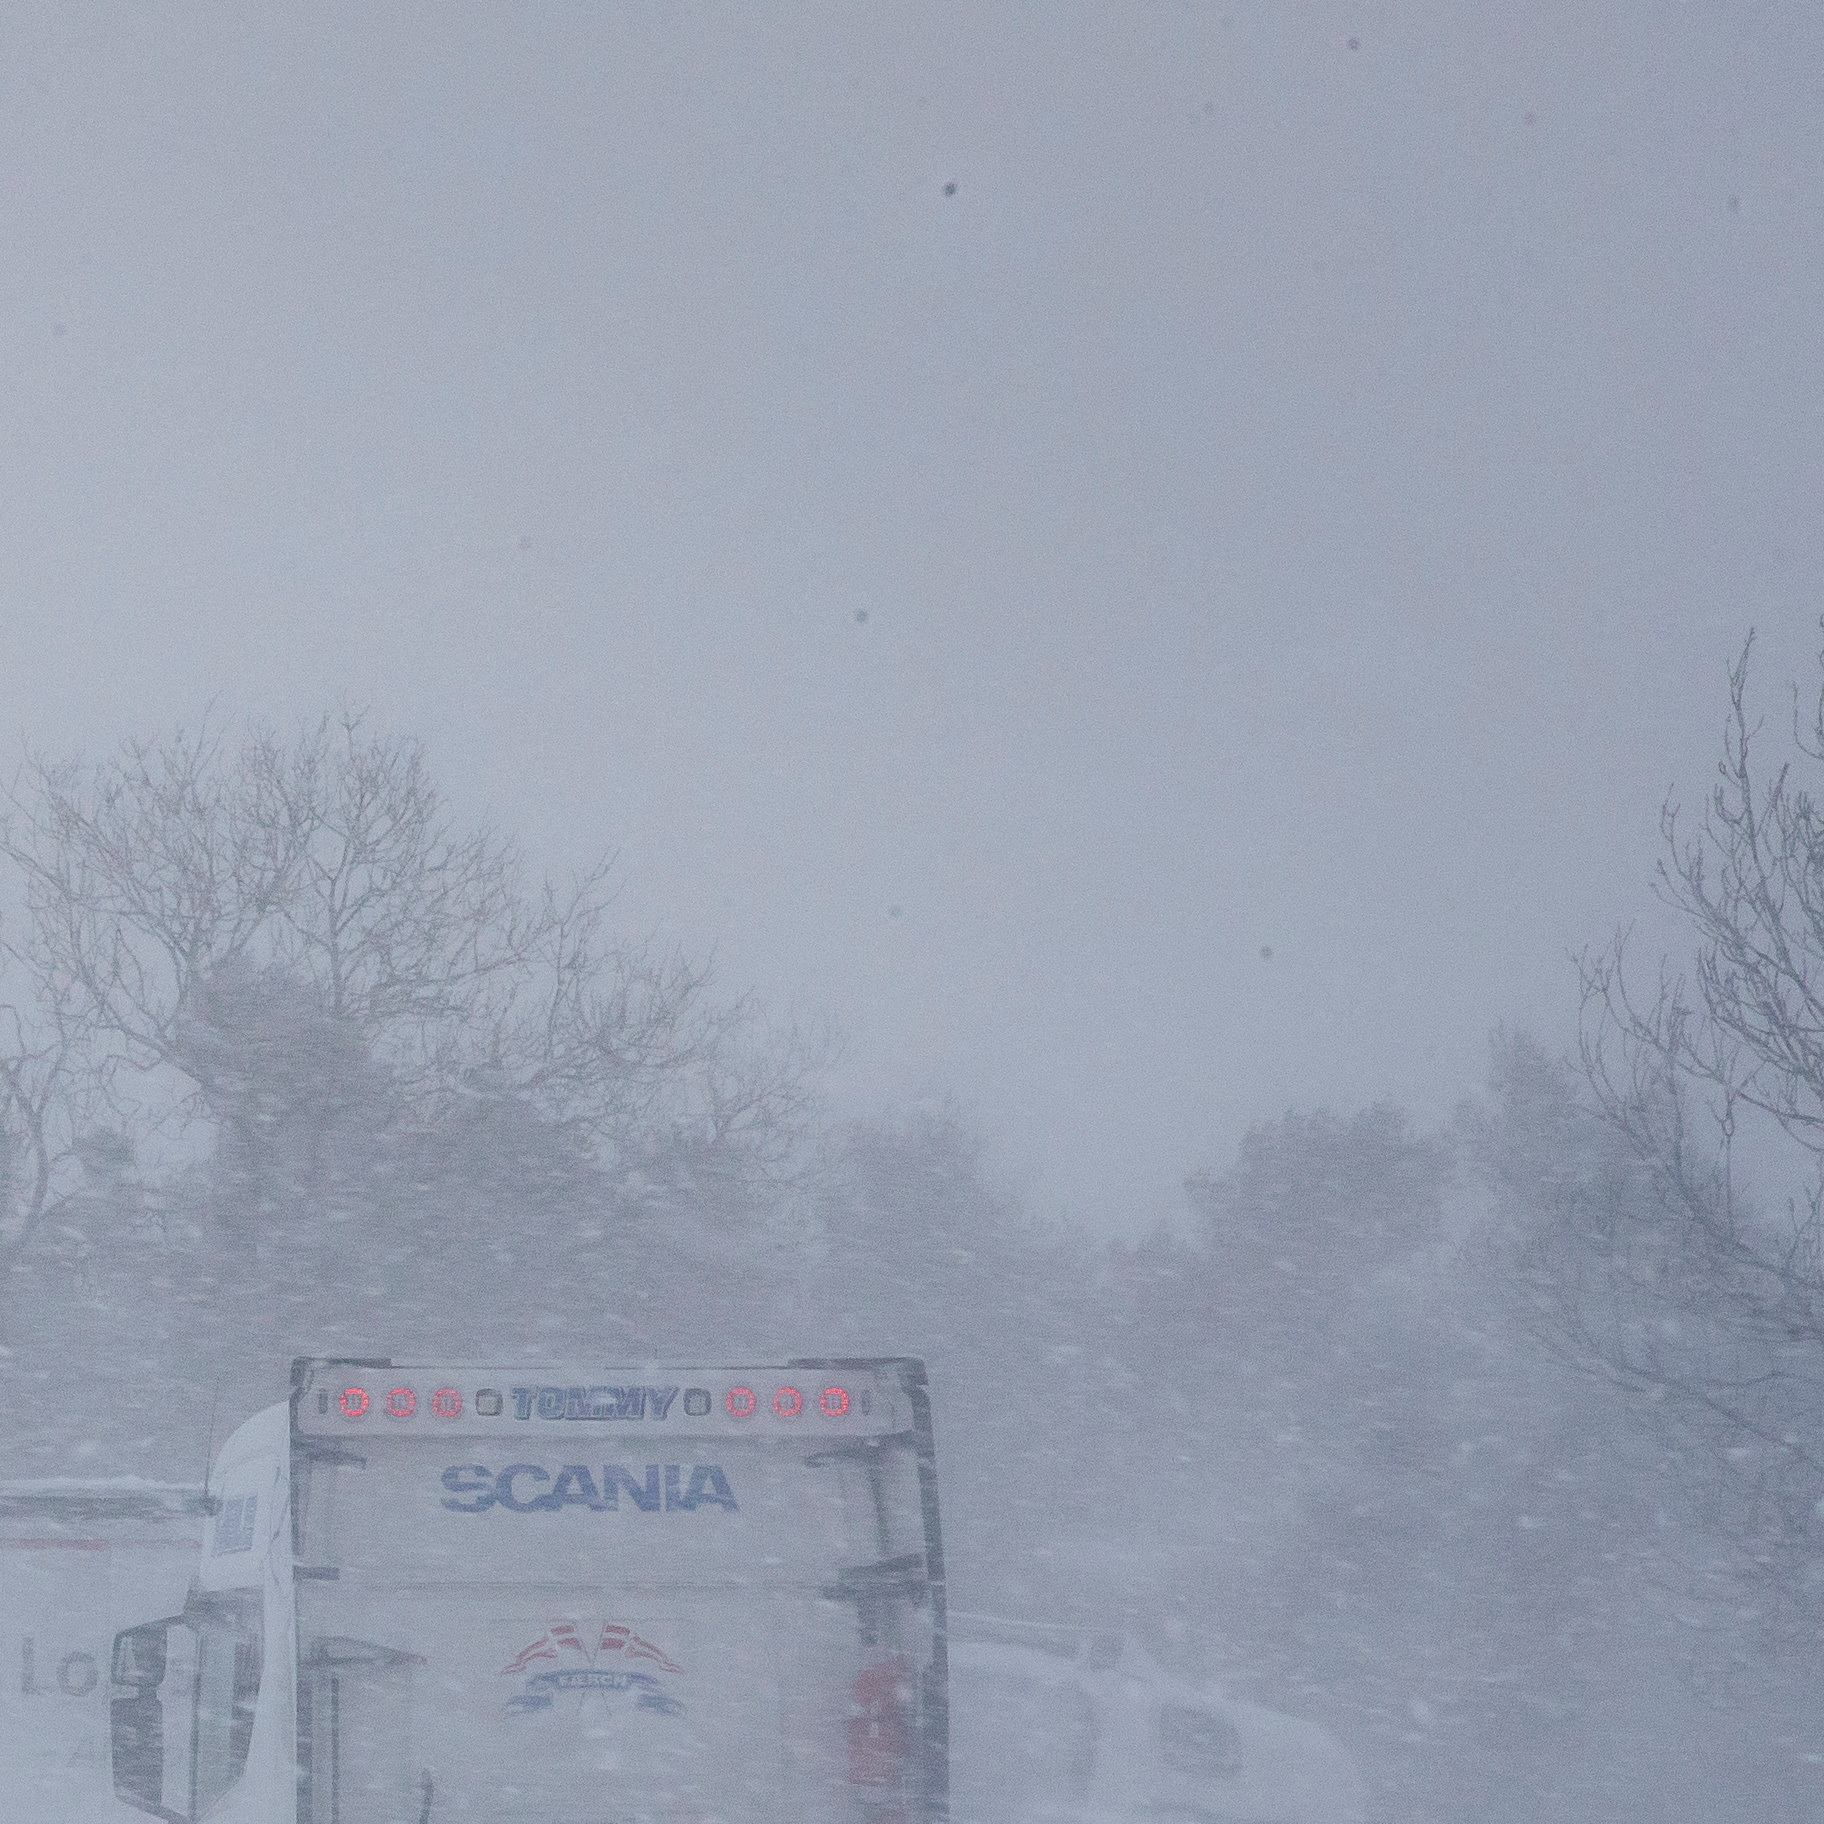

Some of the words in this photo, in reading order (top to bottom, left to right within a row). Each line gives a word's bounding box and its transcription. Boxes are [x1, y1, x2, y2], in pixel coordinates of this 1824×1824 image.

[512, 1385, 679, 1420] TOMMY
[440, 1463, 739, 1513] SCANIA
[19, 1632, 100, 1697] Lo
